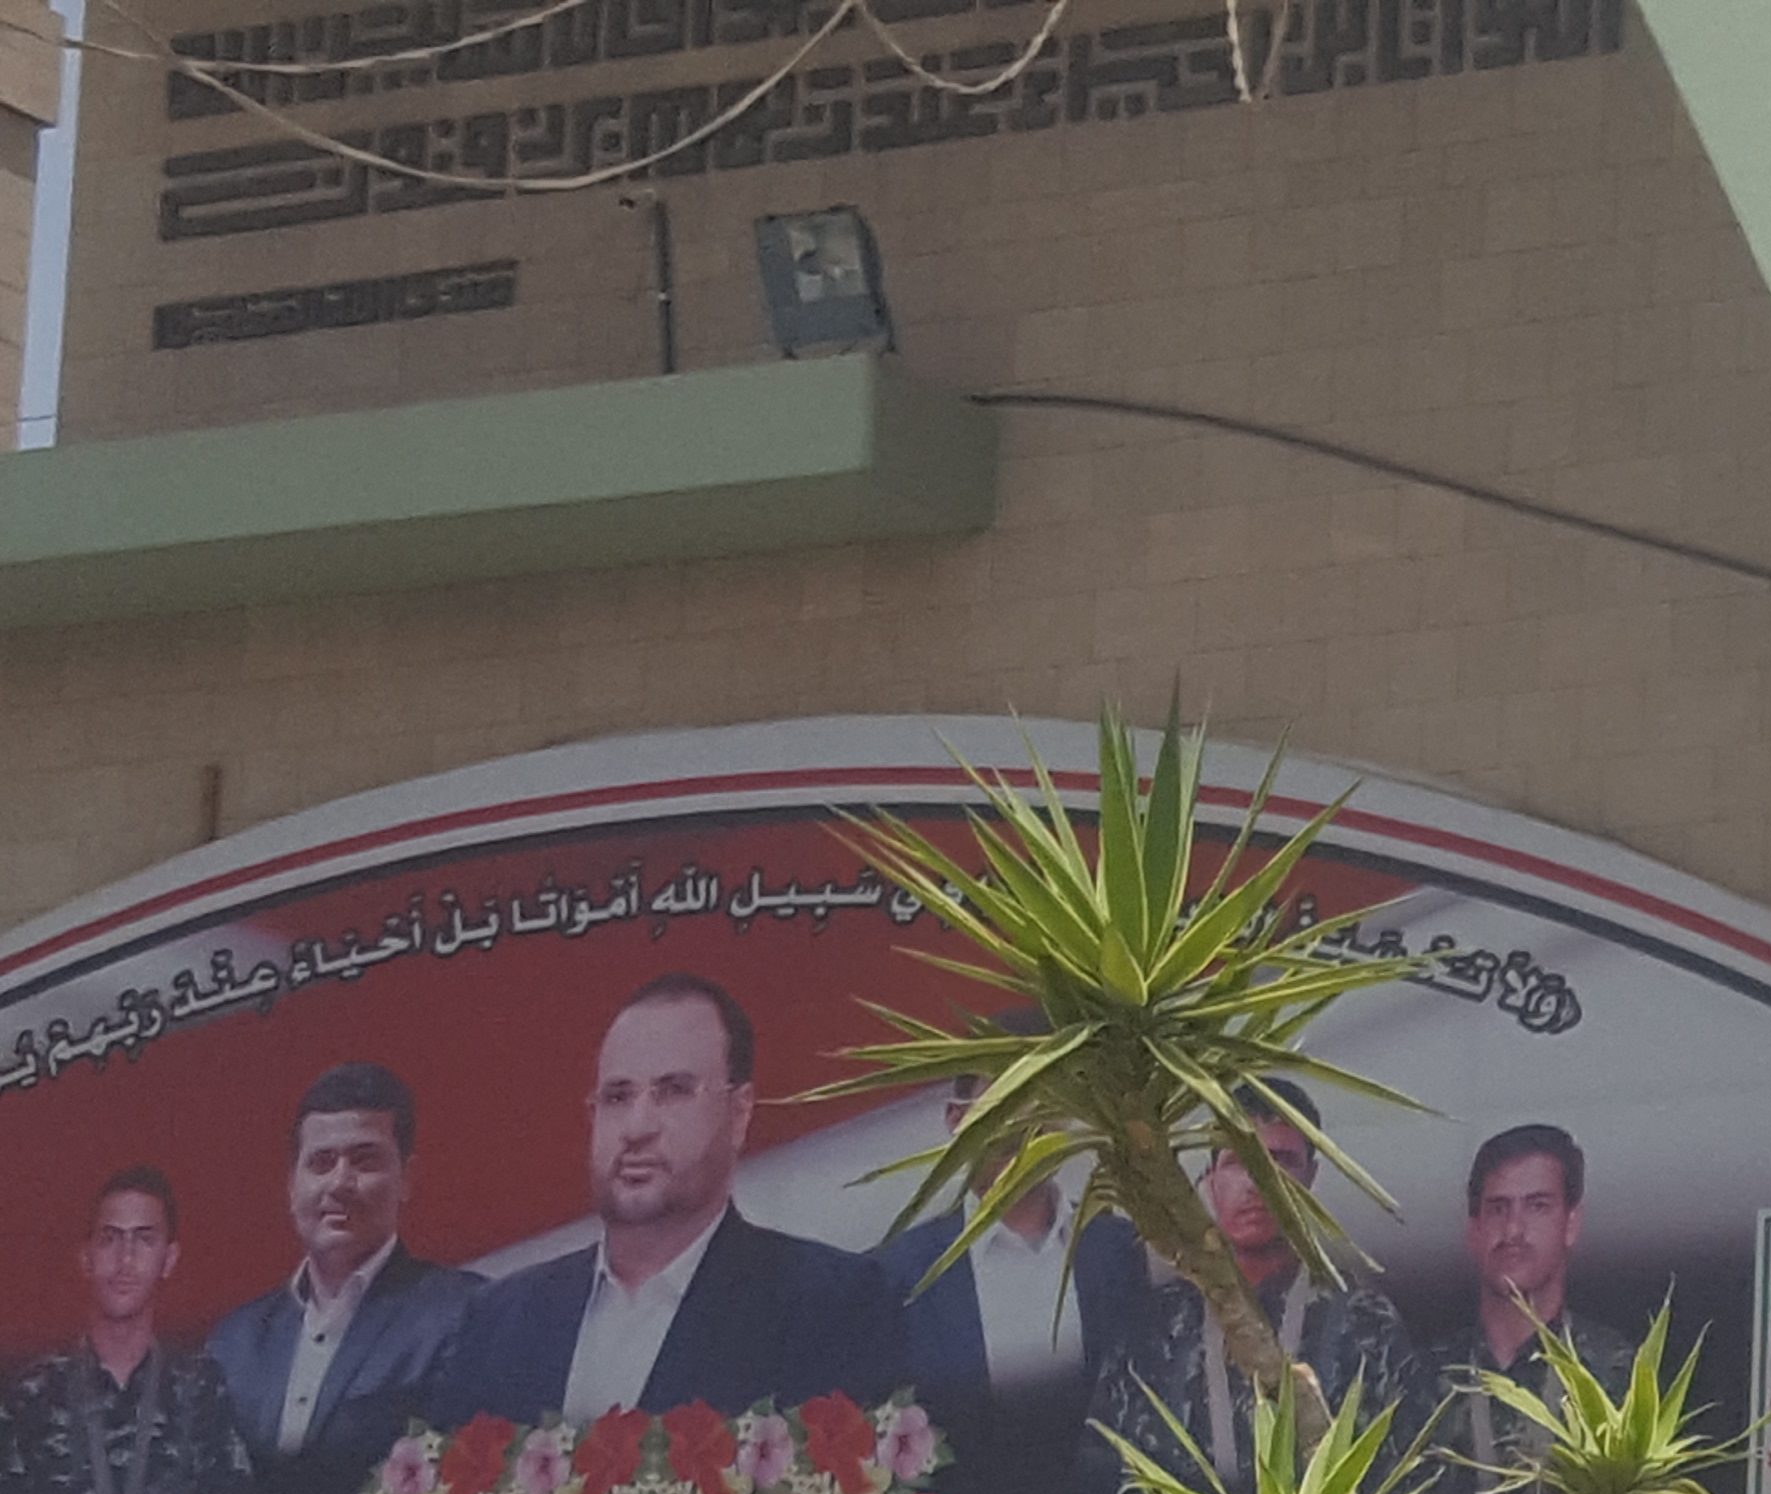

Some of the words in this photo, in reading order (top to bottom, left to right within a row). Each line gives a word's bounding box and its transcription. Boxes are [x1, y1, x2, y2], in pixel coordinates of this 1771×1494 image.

[650, 866, 719, 916] الله
[730, 868, 882, 922] سبيل
[433, 894, 499, 954] بل
[173, 955, 279, 1017] عند
